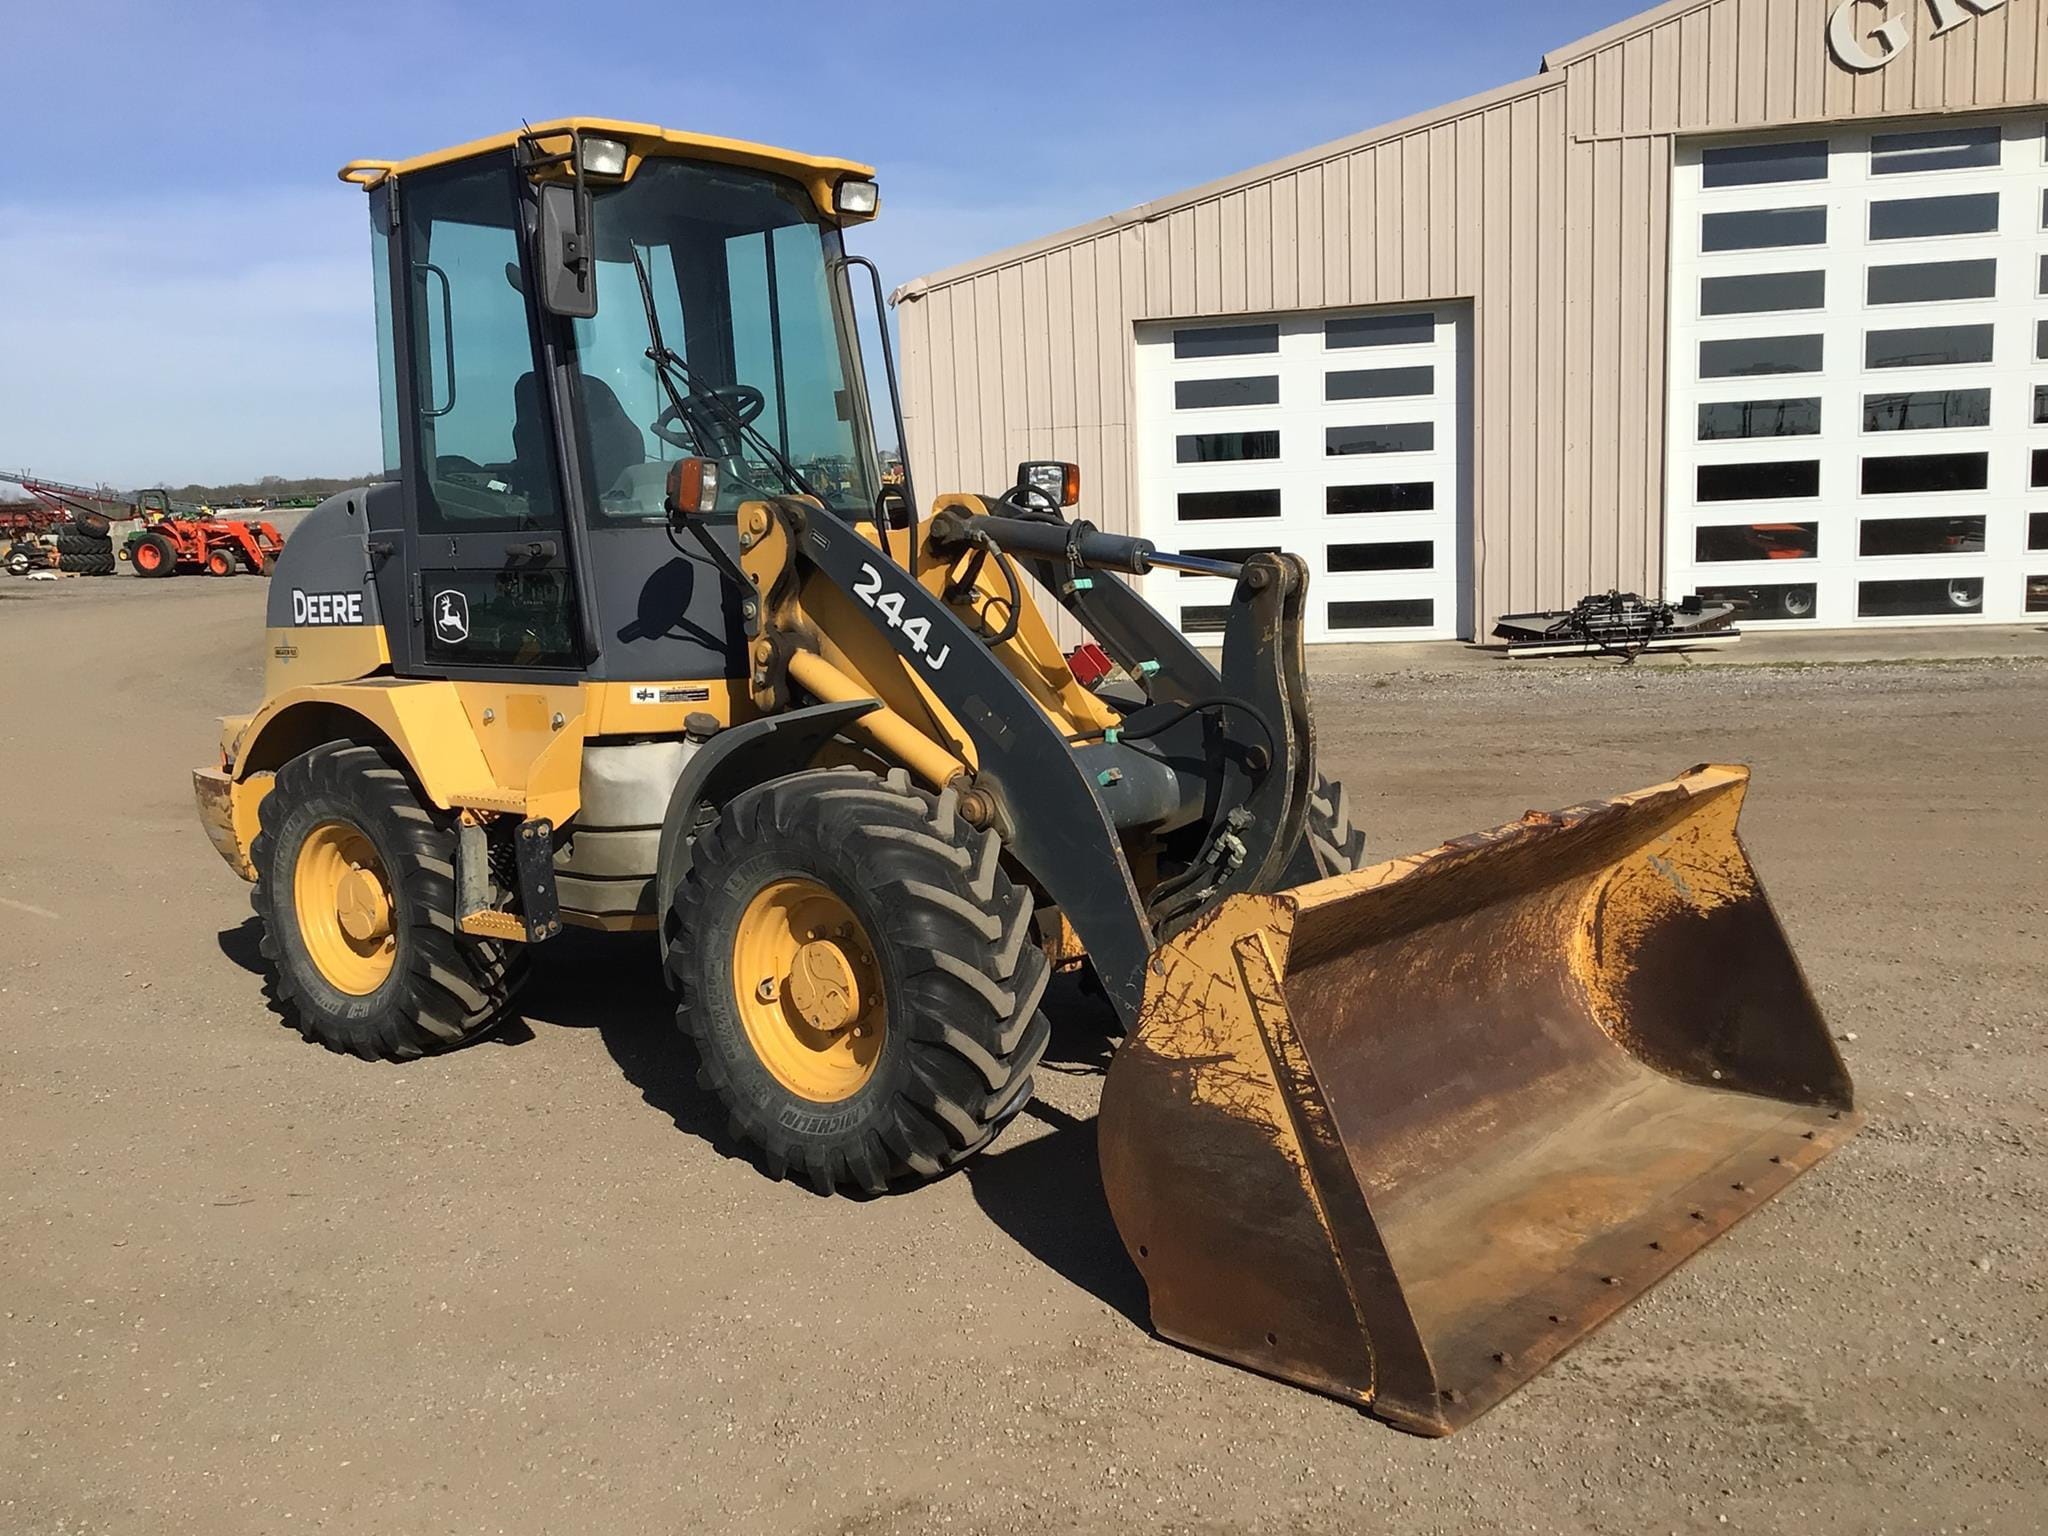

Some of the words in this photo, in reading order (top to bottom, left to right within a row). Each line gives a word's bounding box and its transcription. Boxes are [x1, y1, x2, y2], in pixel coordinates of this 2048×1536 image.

[292, 589, 363, 624] DEERE
[853, 562, 950, 670] 244J
[779, 1106, 860, 1134] MICHELIN
